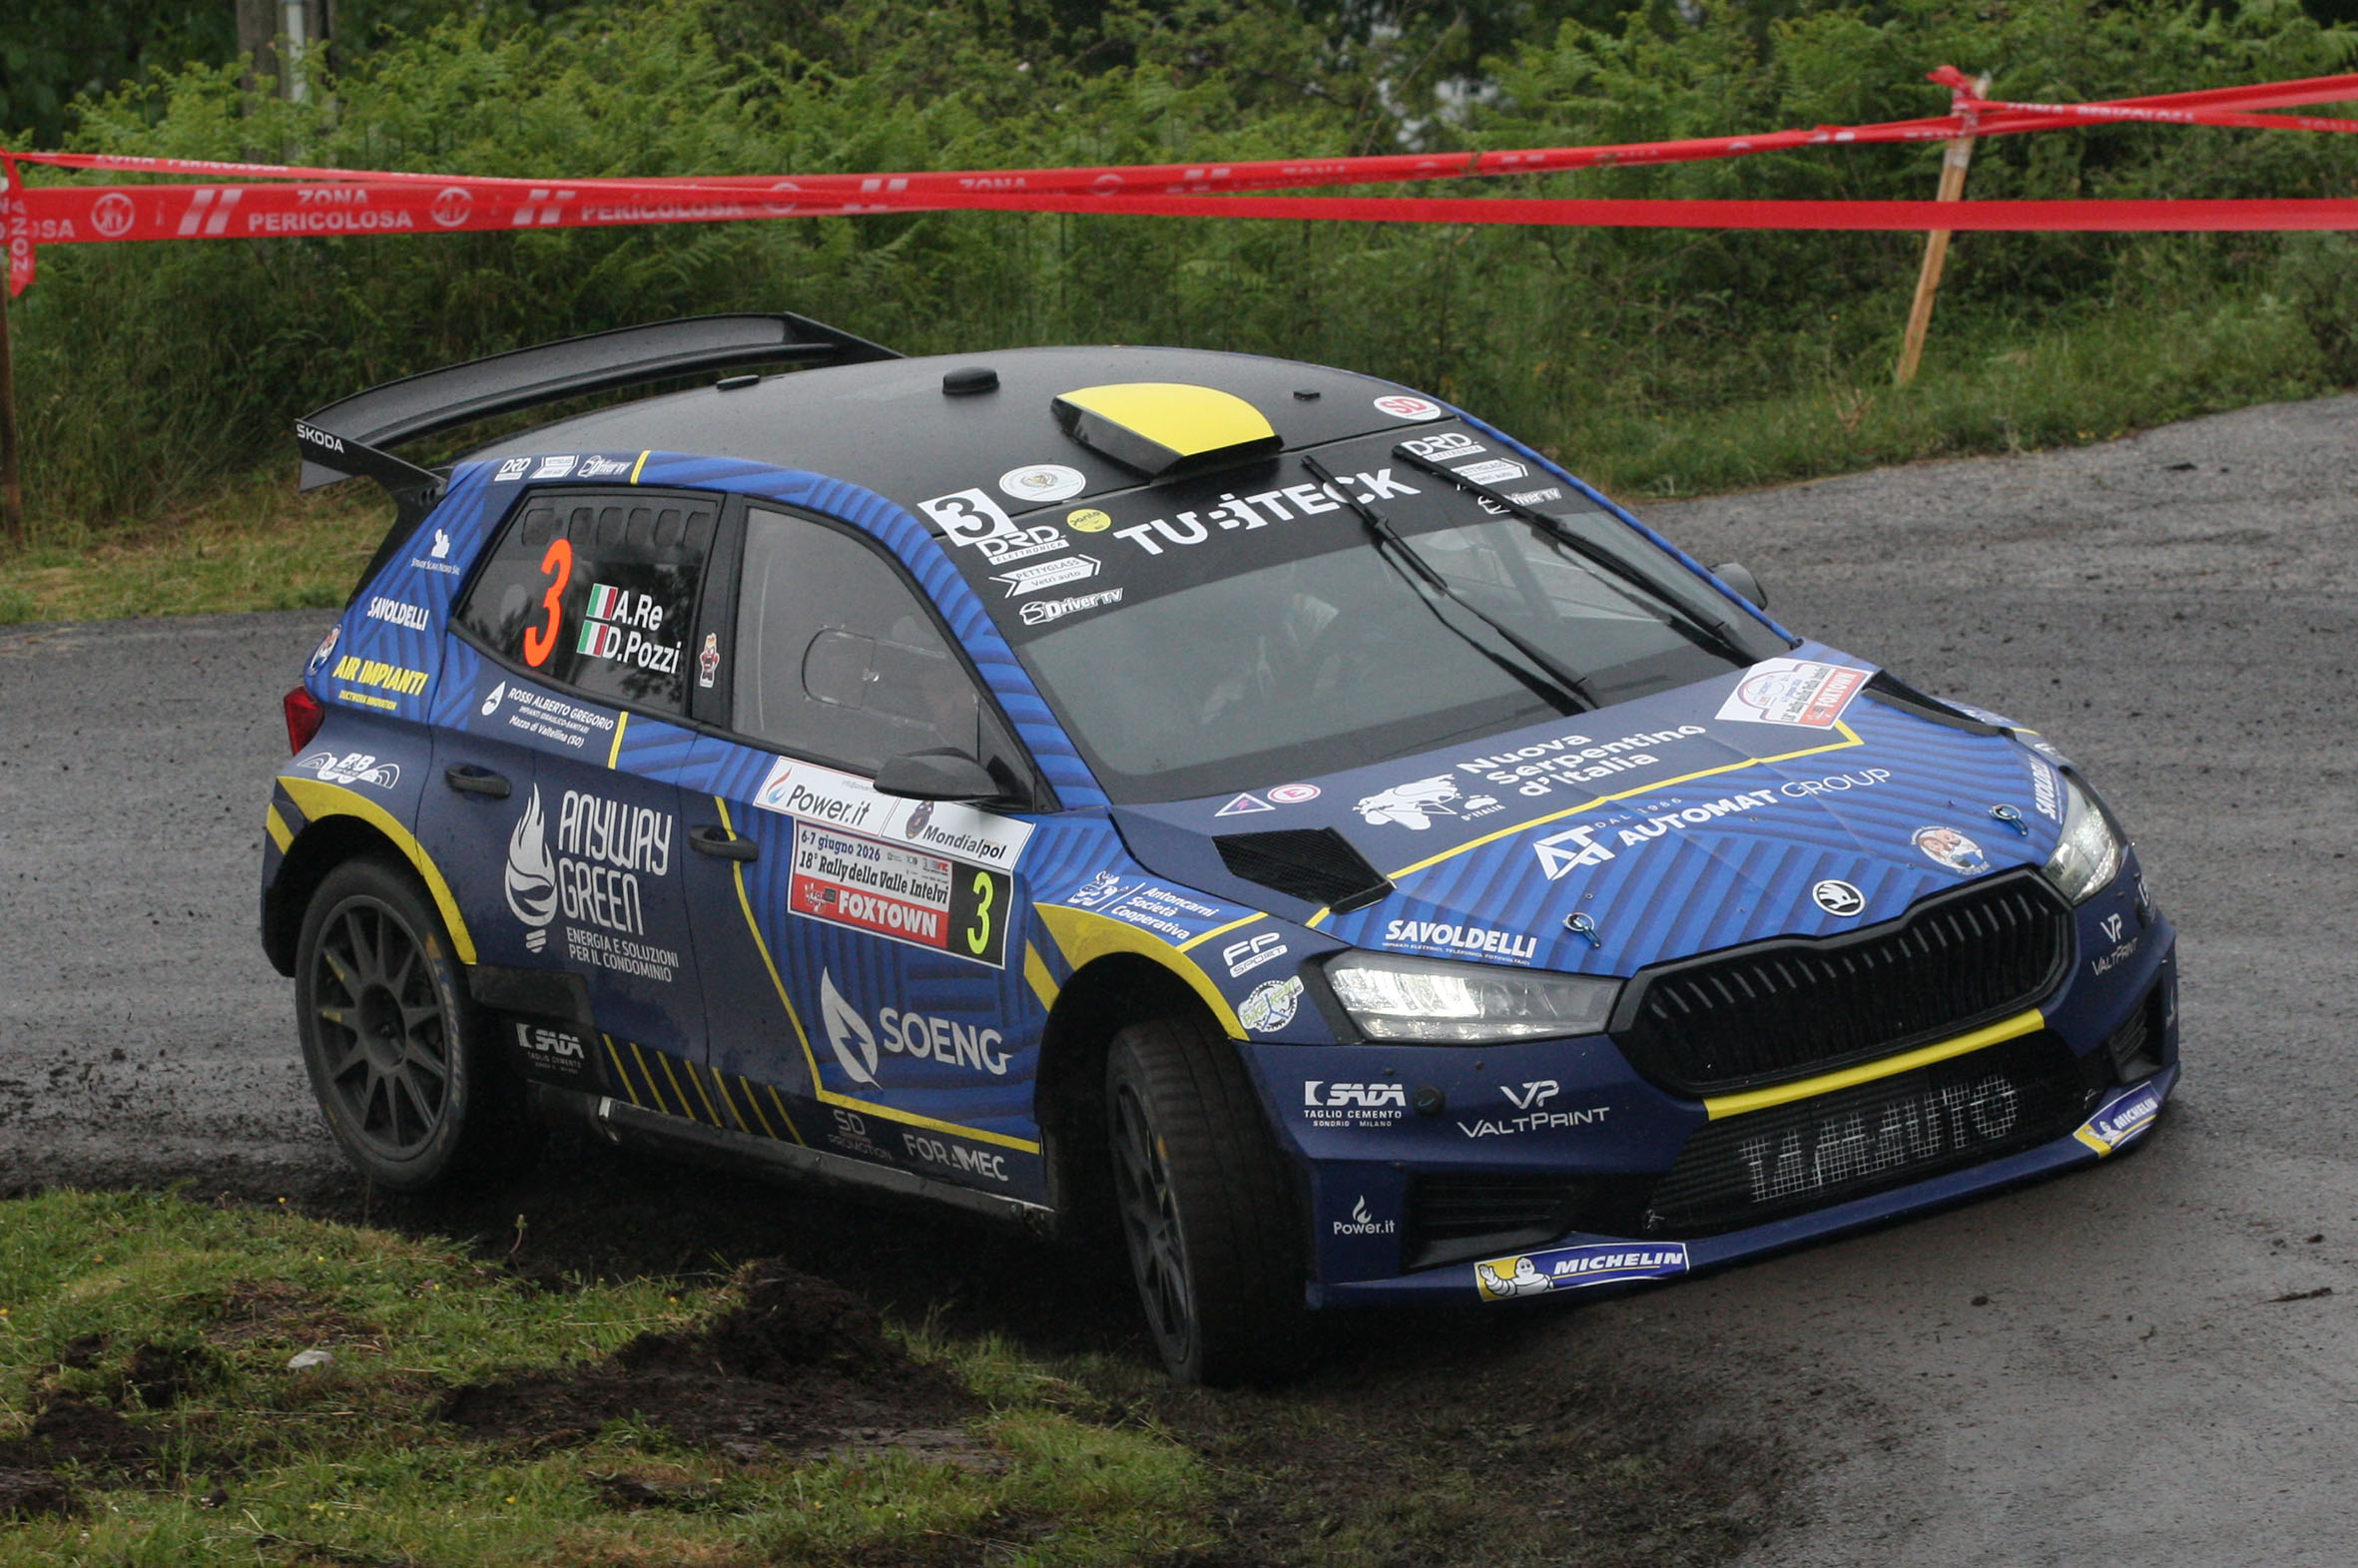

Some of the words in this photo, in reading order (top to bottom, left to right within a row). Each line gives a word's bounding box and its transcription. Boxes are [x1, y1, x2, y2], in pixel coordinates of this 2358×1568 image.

[297, 189, 368, 206] ZONA
[248, 211, 413, 233] PERICOLOSA
[1401, 433, 1473, 456] DRD
[934, 497, 995, 538] 3
[976, 525, 1061, 558] DRD
[995, 541, 1064, 563] ELETTRONICA
[1015, 558, 1081, 580] PETTYGLASS
[1030, 574, 1057, 587] Vetri
[1058, 571, 1081, 582] auto
[367, 596, 429, 631] SAVOLDELLI
[523, 538, 573, 667] 3
[611, 590, 664, 632] A.Re
[1044, 591, 1099, 619] Driver
[1100, 588, 1124, 605] TV
[602, 626, 682, 675] D.Pozzi
[332, 655, 361, 682] AIR
[357, 660, 429, 696] IMPIANTI
[507, 688, 534, 705] ROSSI
[532, 696, 571, 716] ALBERTO
[570, 708, 614, 731] GREGORIO
[509, 715, 530, 730] Mazzo
[530, 722, 538, 732] di
[1456, 734, 1592, 775] Nuova
[1485, 725, 1707, 784] Serpentino
[1518, 754, 1660, 796] d'Italia
[786, 784, 871, 826] Power.it
[1594, 813, 1632, 828] DAL
[1617, 789, 1782, 847] AUTOMAT
[1780, 768, 1891, 797] GROUP
[558, 789, 673, 875] ANYWAY
[801, 830, 817, 846] 6-7
[819, 833, 854, 857] giugno
[857, 844, 881, 862] 2026
[922, 824, 1007, 860] Mondialpol
[558, 857, 644, 936] GREEN
[819, 855, 849, 881] Rally
[849, 861, 879, 886] della
[880, 870, 907, 894] Valle
[909, 878, 948, 904] Intelvi
[839, 888, 938, 938] FOXTOWN
[966, 871, 994, 955] 3
[1126, 895, 1178, 917] Società
[1142, 886, 1221, 918] Antoncarni
[1111, 905, 1191, 940] Cooperativa
[1385, 919, 1538, 959] SAVOLDELLI
[566, 926, 612, 953] ENERGIA
[613, 937, 621, 954] E
[622, 940, 680, 968] SOLUZIONI
[569, 943, 593, 964] PER
[592, 950, 601, 966] IL
[603, 952, 673, 983] CONDOMINIO
[1233, 946, 1286, 975] SPORT
[880, 1007, 1012, 1075] SOENG
[1326, 1083, 1407, 1107] SADA
[833, 1109, 866, 1136] SD
[1304, 1110, 1343, 1119] TAGLIO
[1347, 1110, 1402, 1119] CEMENTO
[1457, 1107, 1610, 1138] VALTPRINT
[2113, 1097, 2159, 1131] MICHELIN
[1333, 1220, 1396, 1236] Power.it
[1553, 1252, 1684, 1275] MICHELIN
